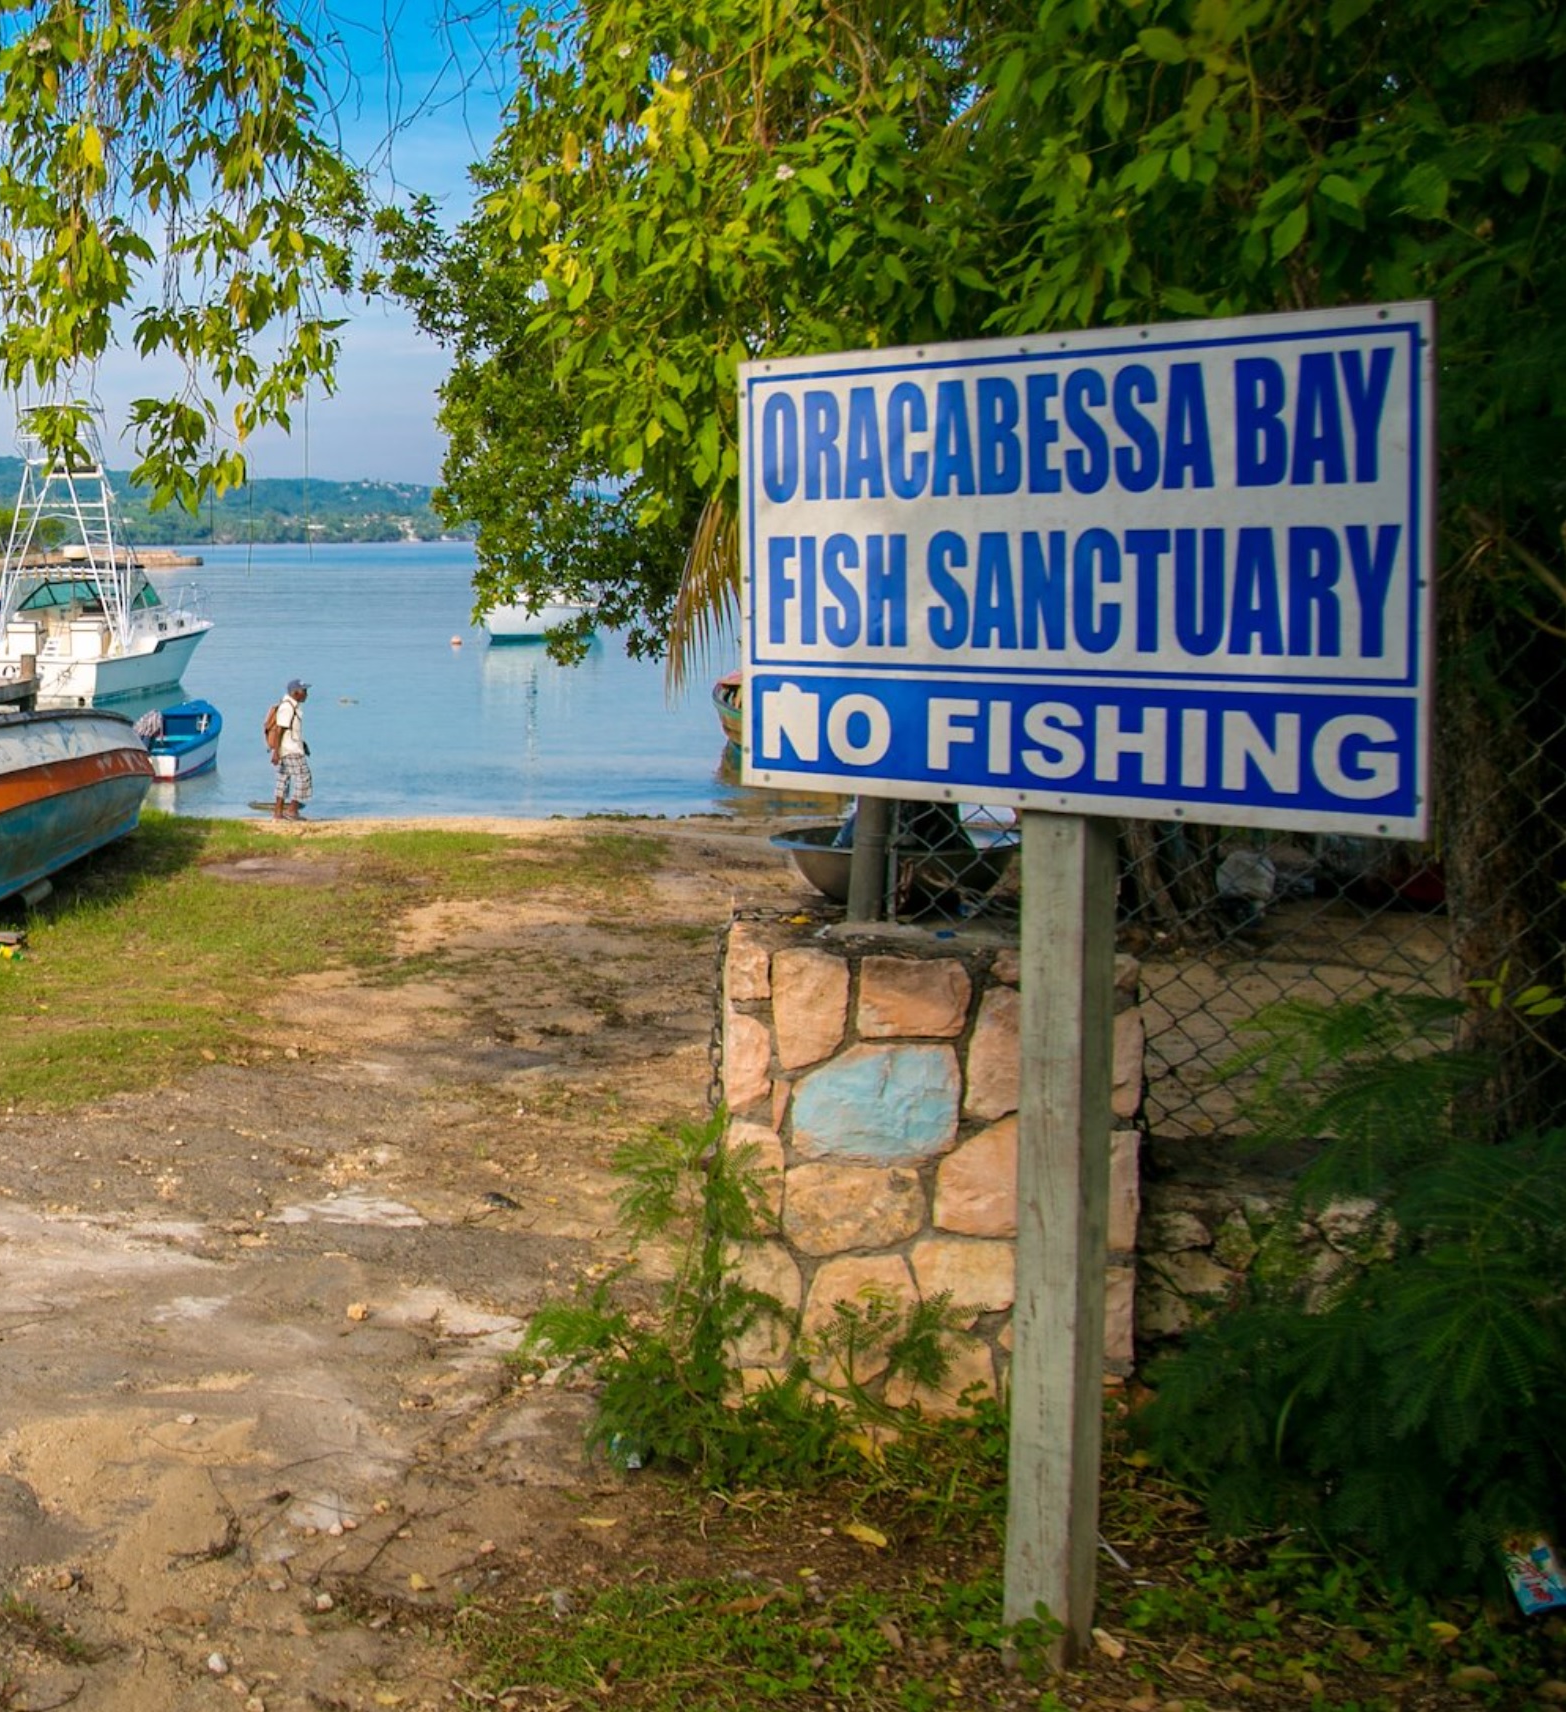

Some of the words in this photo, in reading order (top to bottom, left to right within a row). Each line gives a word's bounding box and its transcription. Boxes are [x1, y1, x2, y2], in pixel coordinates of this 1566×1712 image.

[762, 362, 1215, 504] ORACABESSA
[1234, 347, 1396, 487] BAY
[767, 533, 908, 648] FISH
[926, 524, 1403, 659] SANCTUARY
[761, 683, 891, 767] NO
[927, 697, 1400, 801] FISHING
